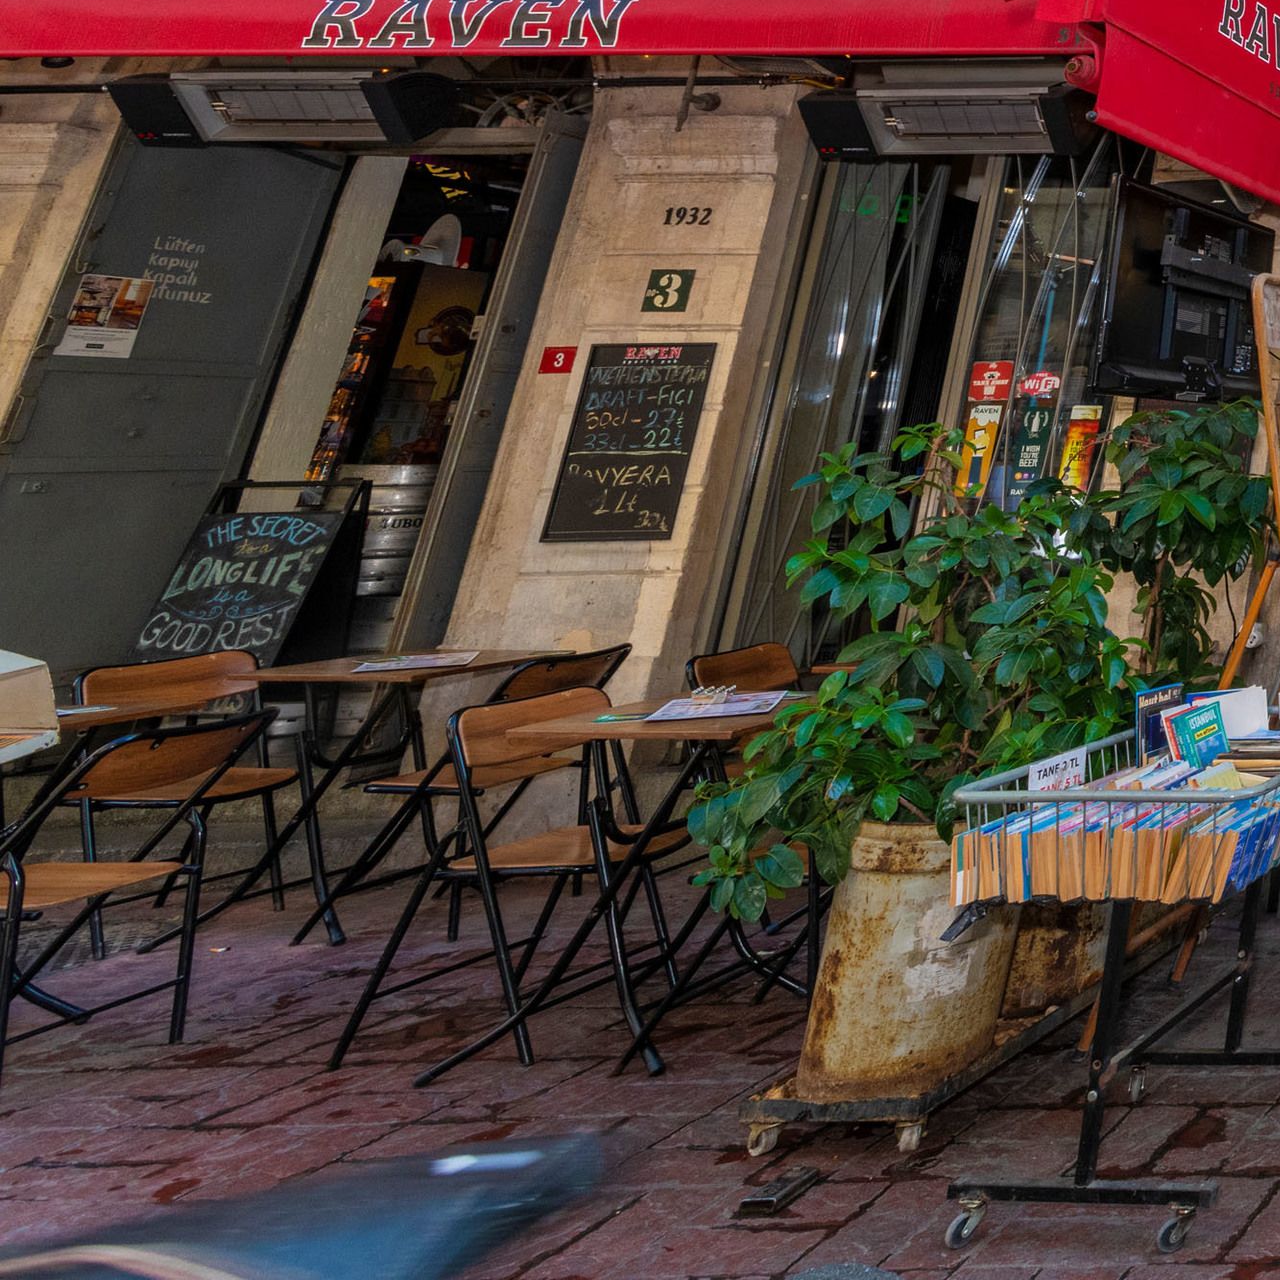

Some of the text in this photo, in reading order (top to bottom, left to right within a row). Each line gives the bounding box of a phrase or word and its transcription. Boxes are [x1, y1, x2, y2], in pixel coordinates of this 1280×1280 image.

[663, 206, 713, 226] 1932
[153, 235, 206, 254] Lütfen
[151, 284, 213, 305] utunuz
[653, 273, 683, 308] 3
[553, 352, 565, 368] 3
[974, 407, 999, 415] RAVEN
[1018, 458, 1038, 468] BEER
[206, 515, 328, 549] THE SECRET
[161, 545, 327, 602] LONG LIFE
[137, 596, 299, 652] GOOD REST
